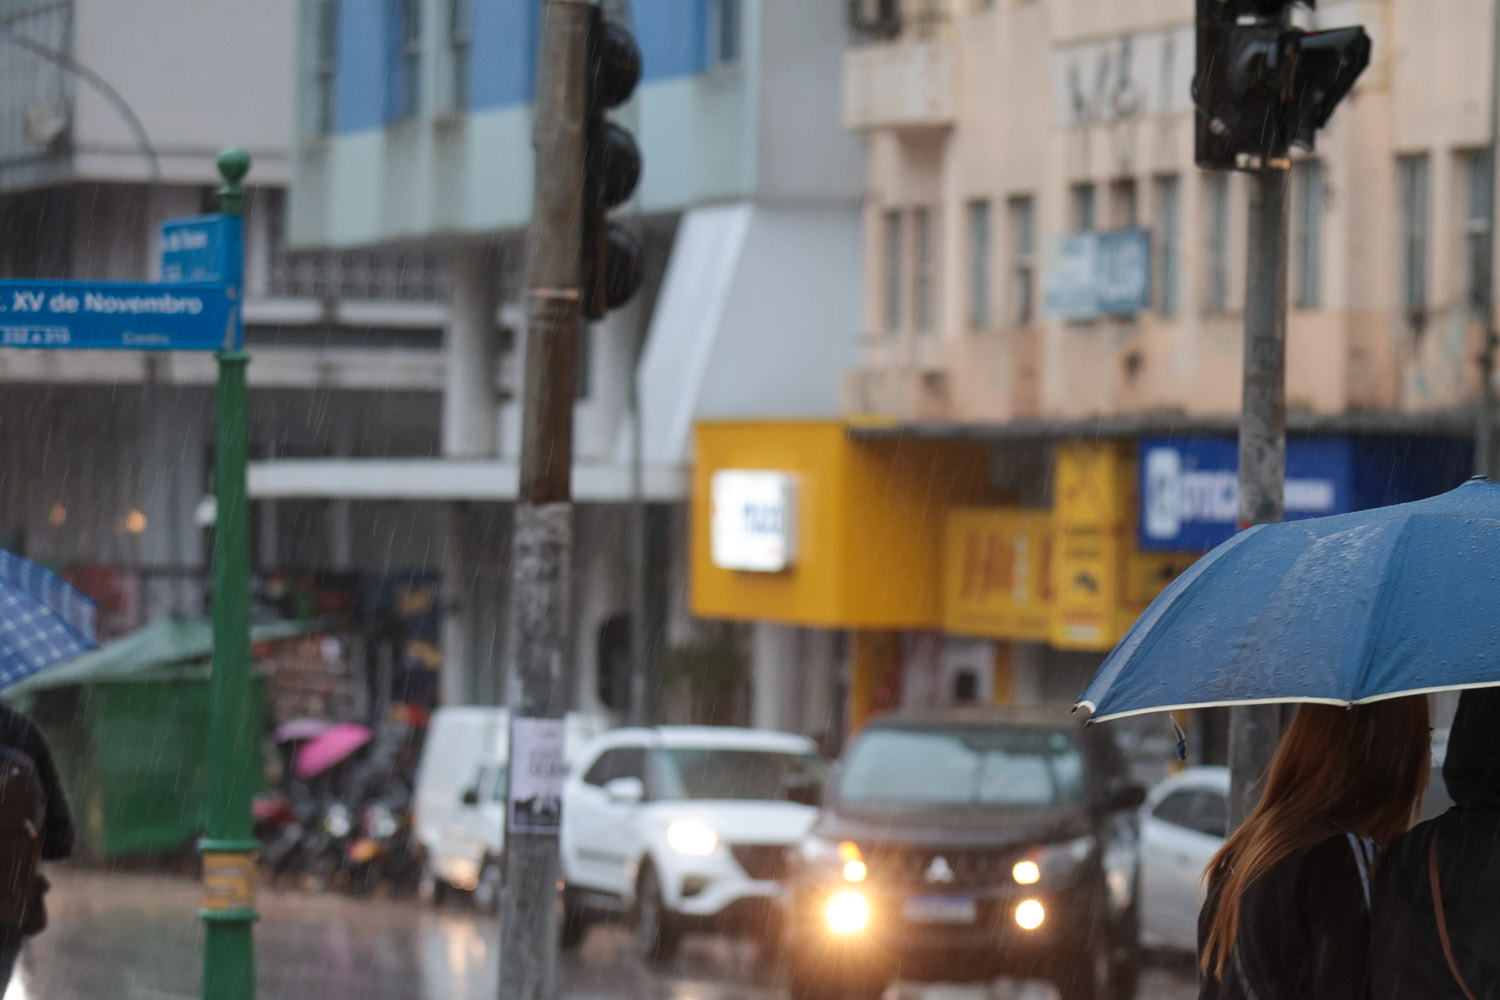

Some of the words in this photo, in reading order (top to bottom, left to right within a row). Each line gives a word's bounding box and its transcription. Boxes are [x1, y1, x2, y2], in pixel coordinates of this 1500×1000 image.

[13, 290, 45, 312] XV
[49, 291, 79, 314] de
[84, 291, 204, 315] Novembro
